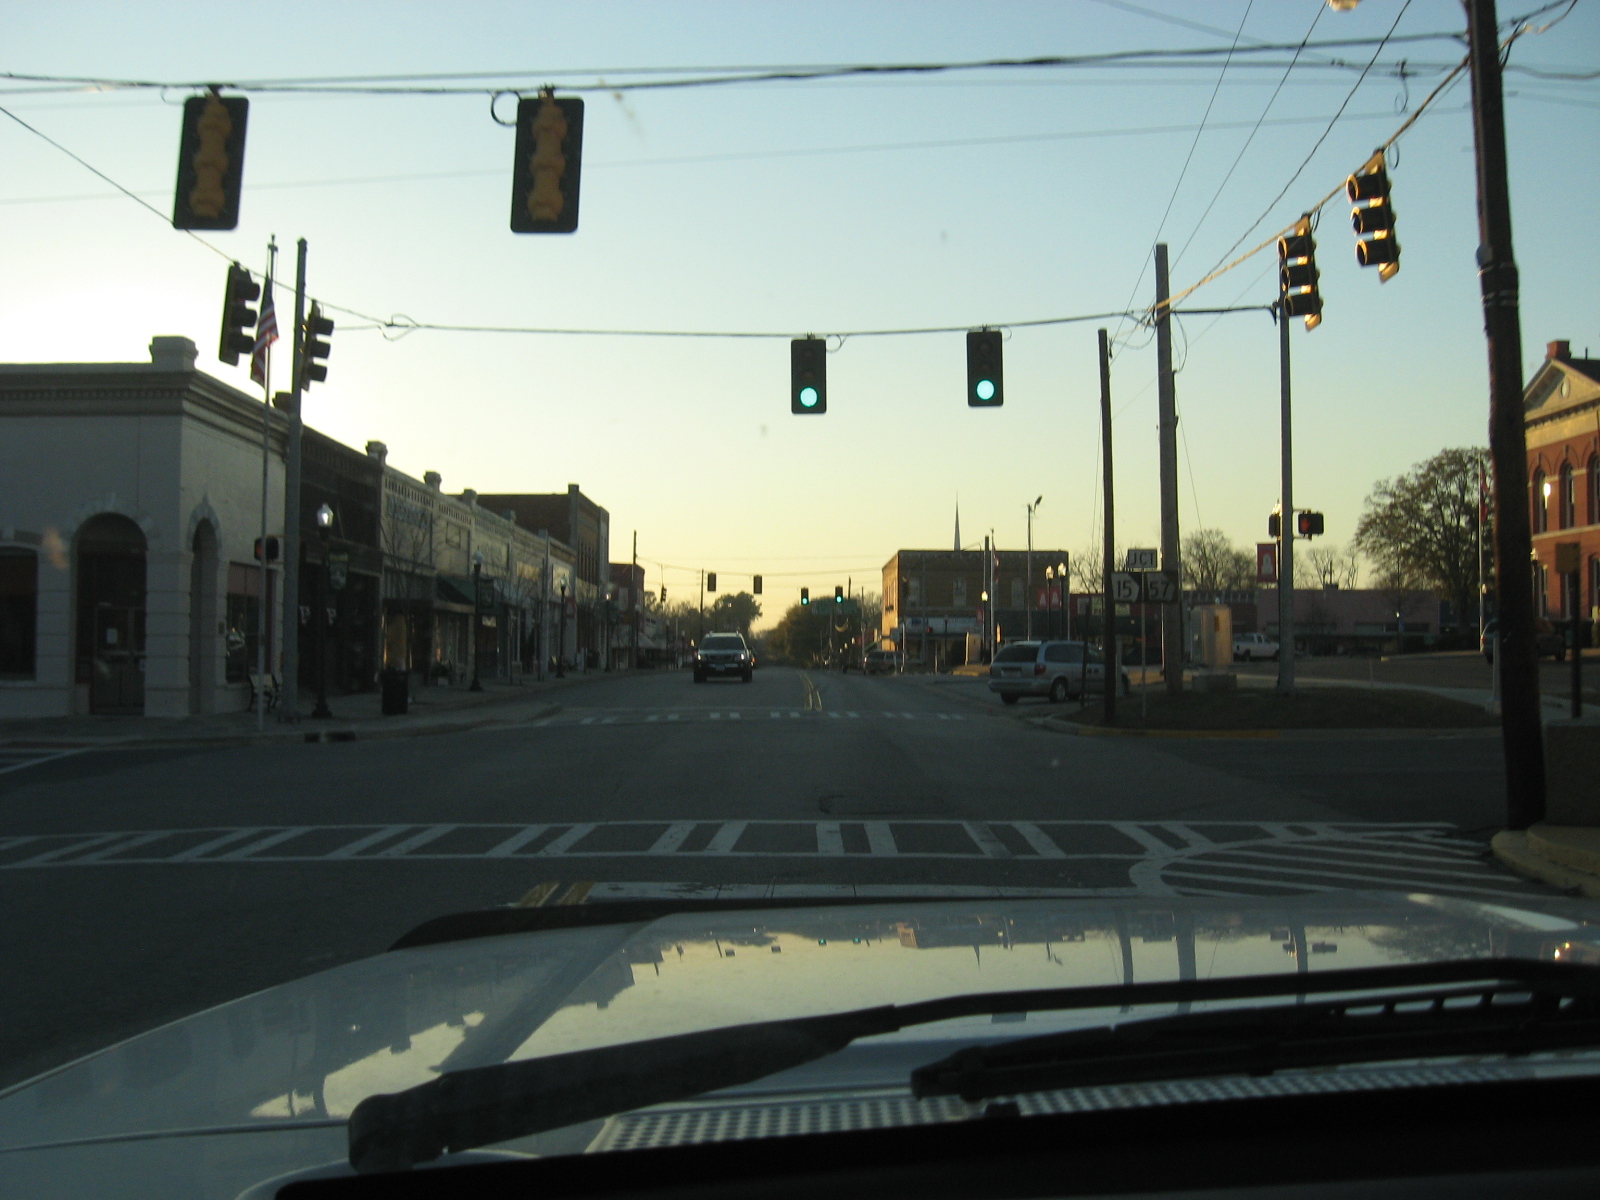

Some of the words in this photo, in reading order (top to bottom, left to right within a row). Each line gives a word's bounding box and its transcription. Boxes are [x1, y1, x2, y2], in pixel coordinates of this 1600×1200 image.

[1130, 551, 1154, 566] JCT
[1117, 580, 1132, 598] 15
[1149, 580, 1171, 598] 57
